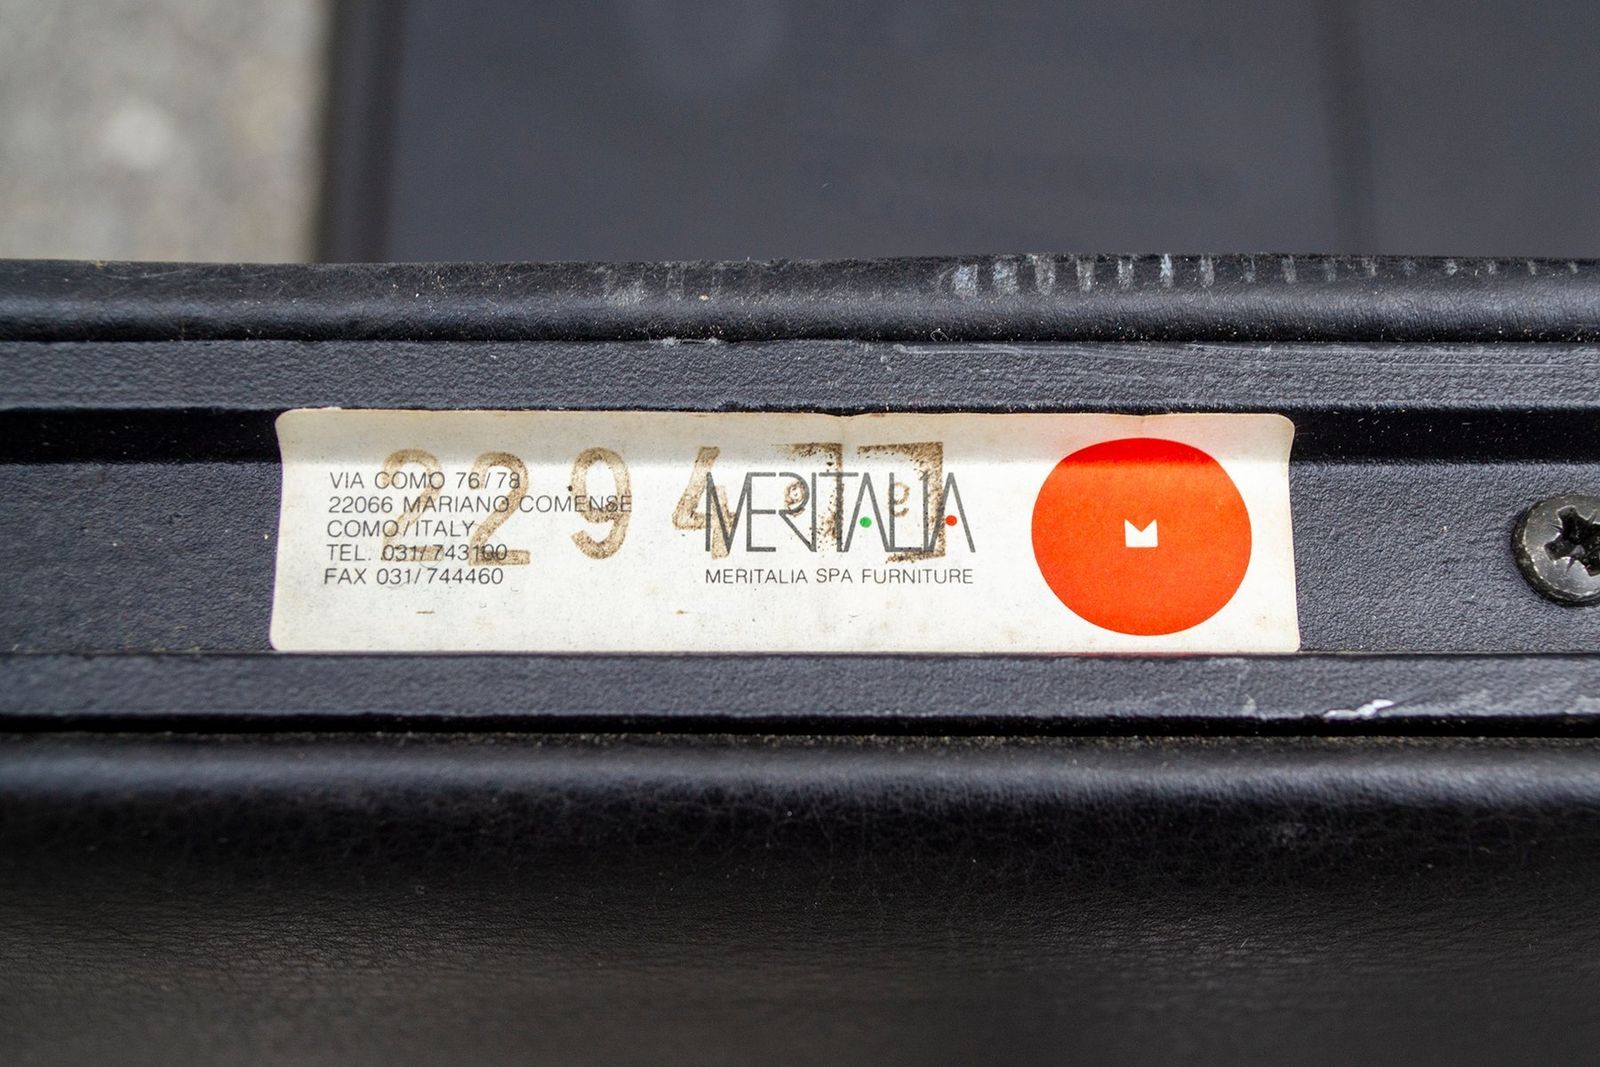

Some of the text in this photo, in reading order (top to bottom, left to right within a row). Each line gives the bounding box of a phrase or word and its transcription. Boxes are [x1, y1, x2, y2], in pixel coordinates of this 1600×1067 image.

[330, 471, 521, 490] VIA COMO 76/78
[328, 494, 633, 514] 22066 MARIANO COMENSE
[705, 471, 976, 553] MERITALIA
[326, 544, 372, 561] TEL.
[324, 567, 367, 585] FAX
[705, 568, 974, 584] MERITALIA SPA FURNITURE
